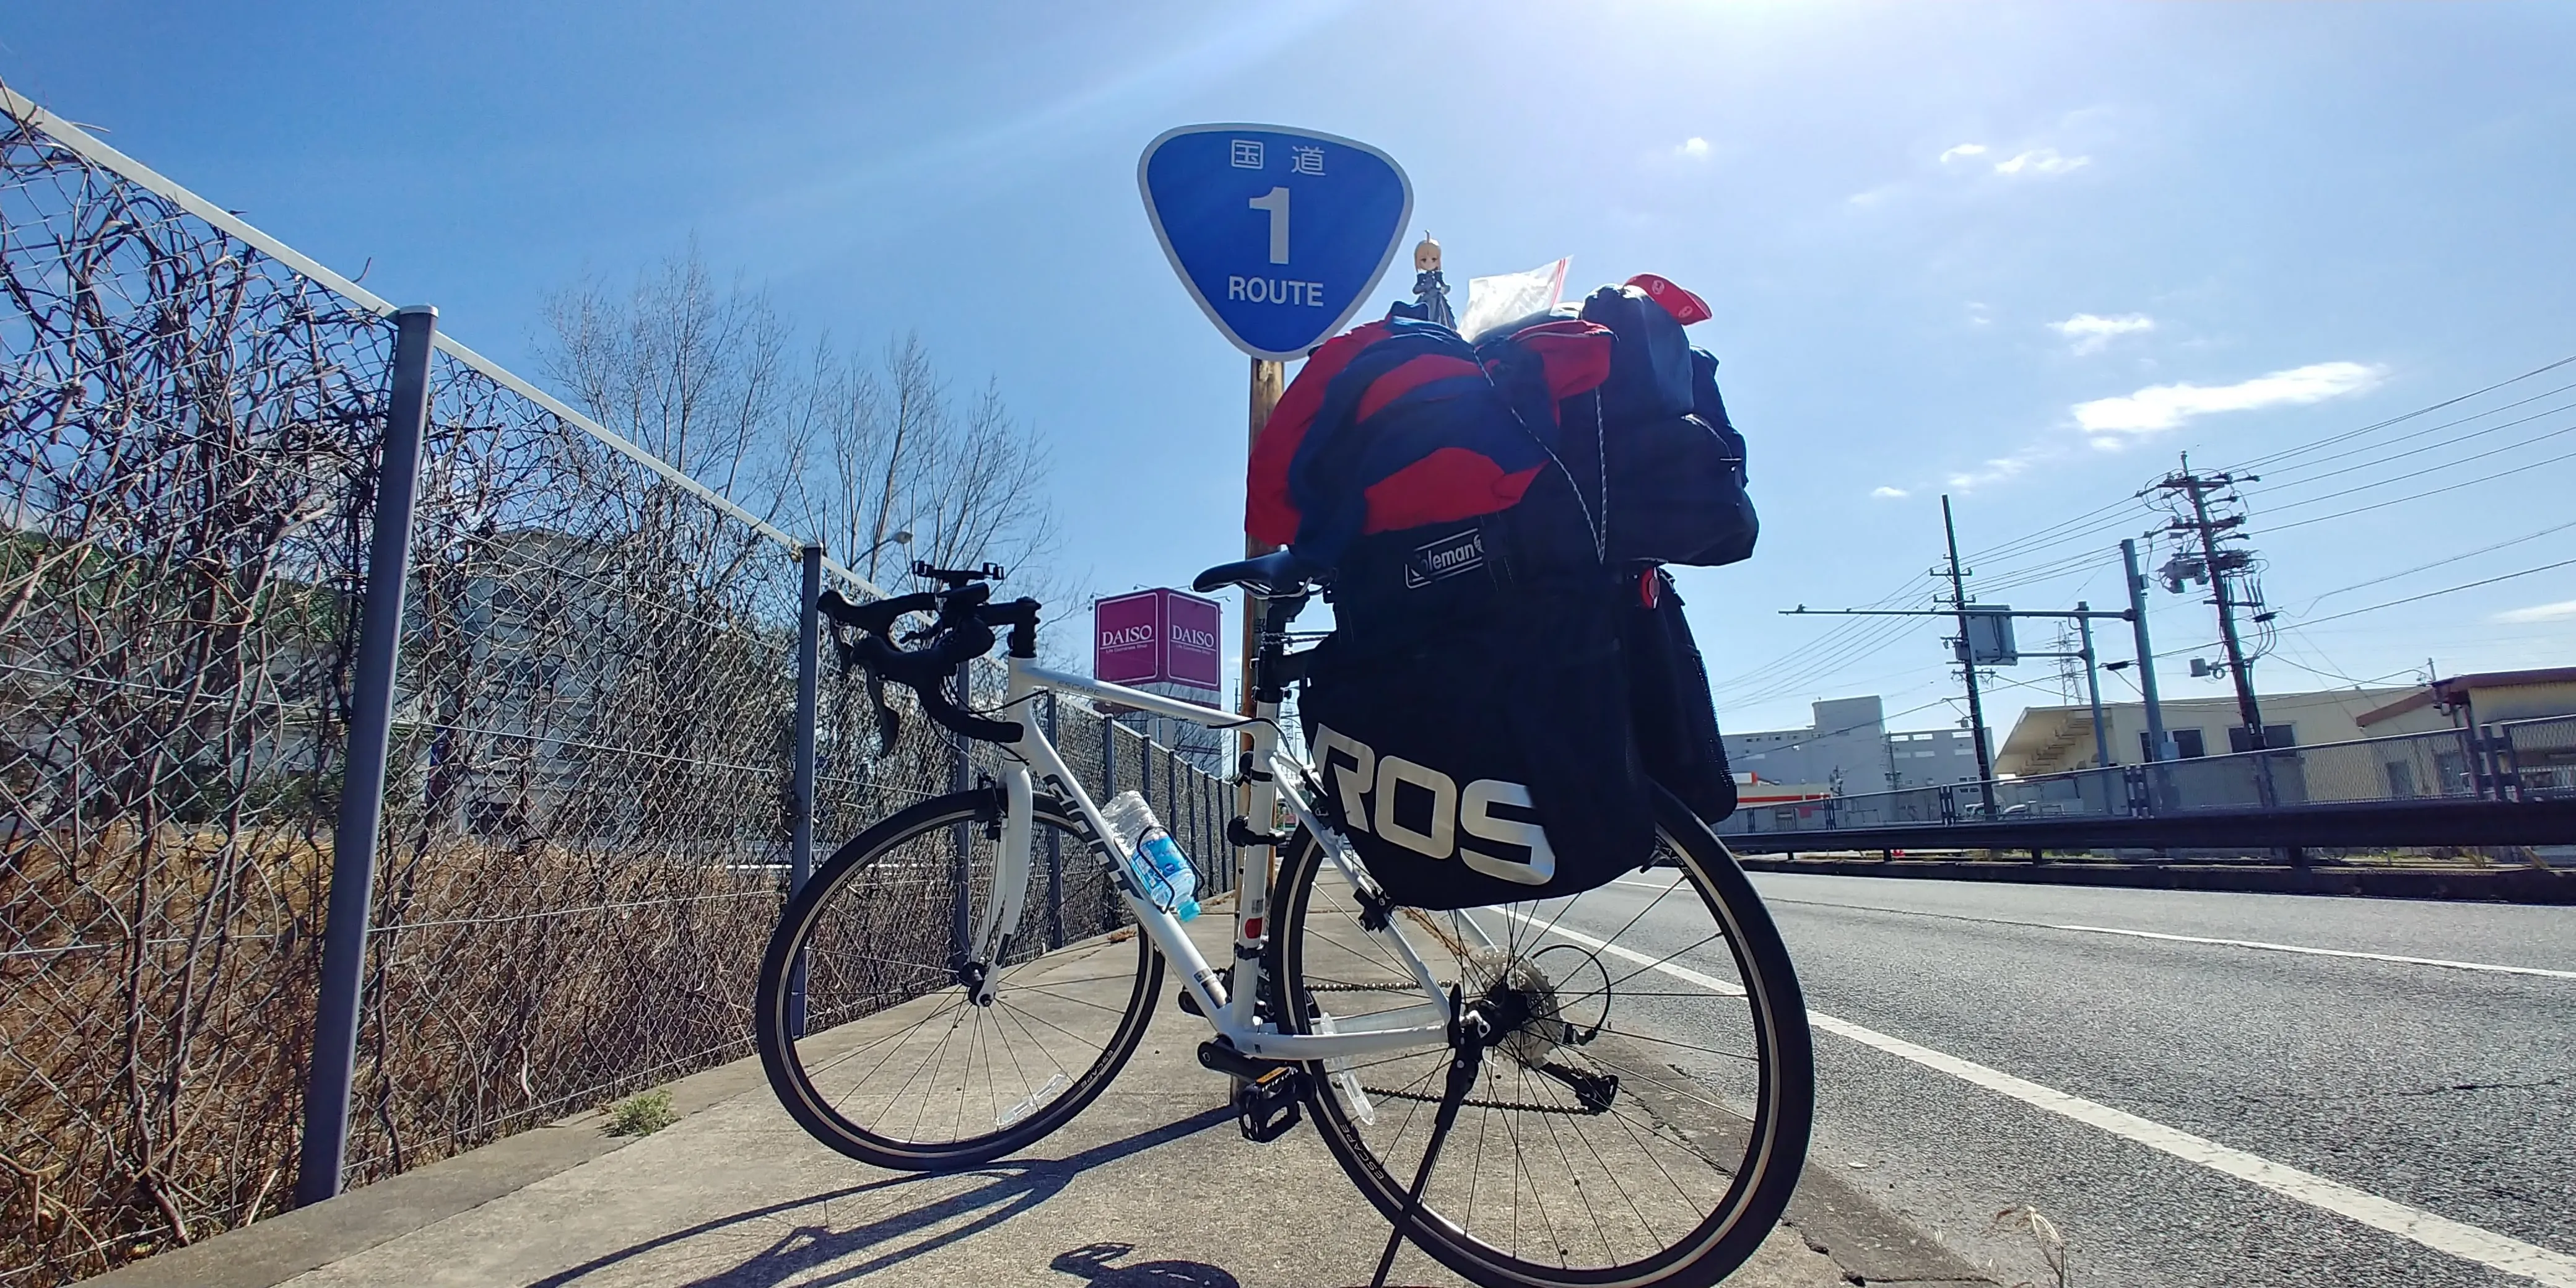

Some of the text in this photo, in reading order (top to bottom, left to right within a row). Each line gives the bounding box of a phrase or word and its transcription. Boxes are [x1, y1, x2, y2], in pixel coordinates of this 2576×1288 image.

[1231, 139, 1326, 176] 国道
[1249, 186, 1290, 264] 1
[1229, 276, 1324, 307] ROUTE
[1411, 543, 1475, 577] leman
[1102, 625, 1152, 646] DAISO
[1172, 624, 1214, 648] DAISO
[1057, 681, 1102, 695] ESCAPE
[1312, 723, 1556, 886] ROS
[1081, 1050, 1113, 1088] ESCAPE
[1340, 1123, 1385, 1180] ESCAPE
